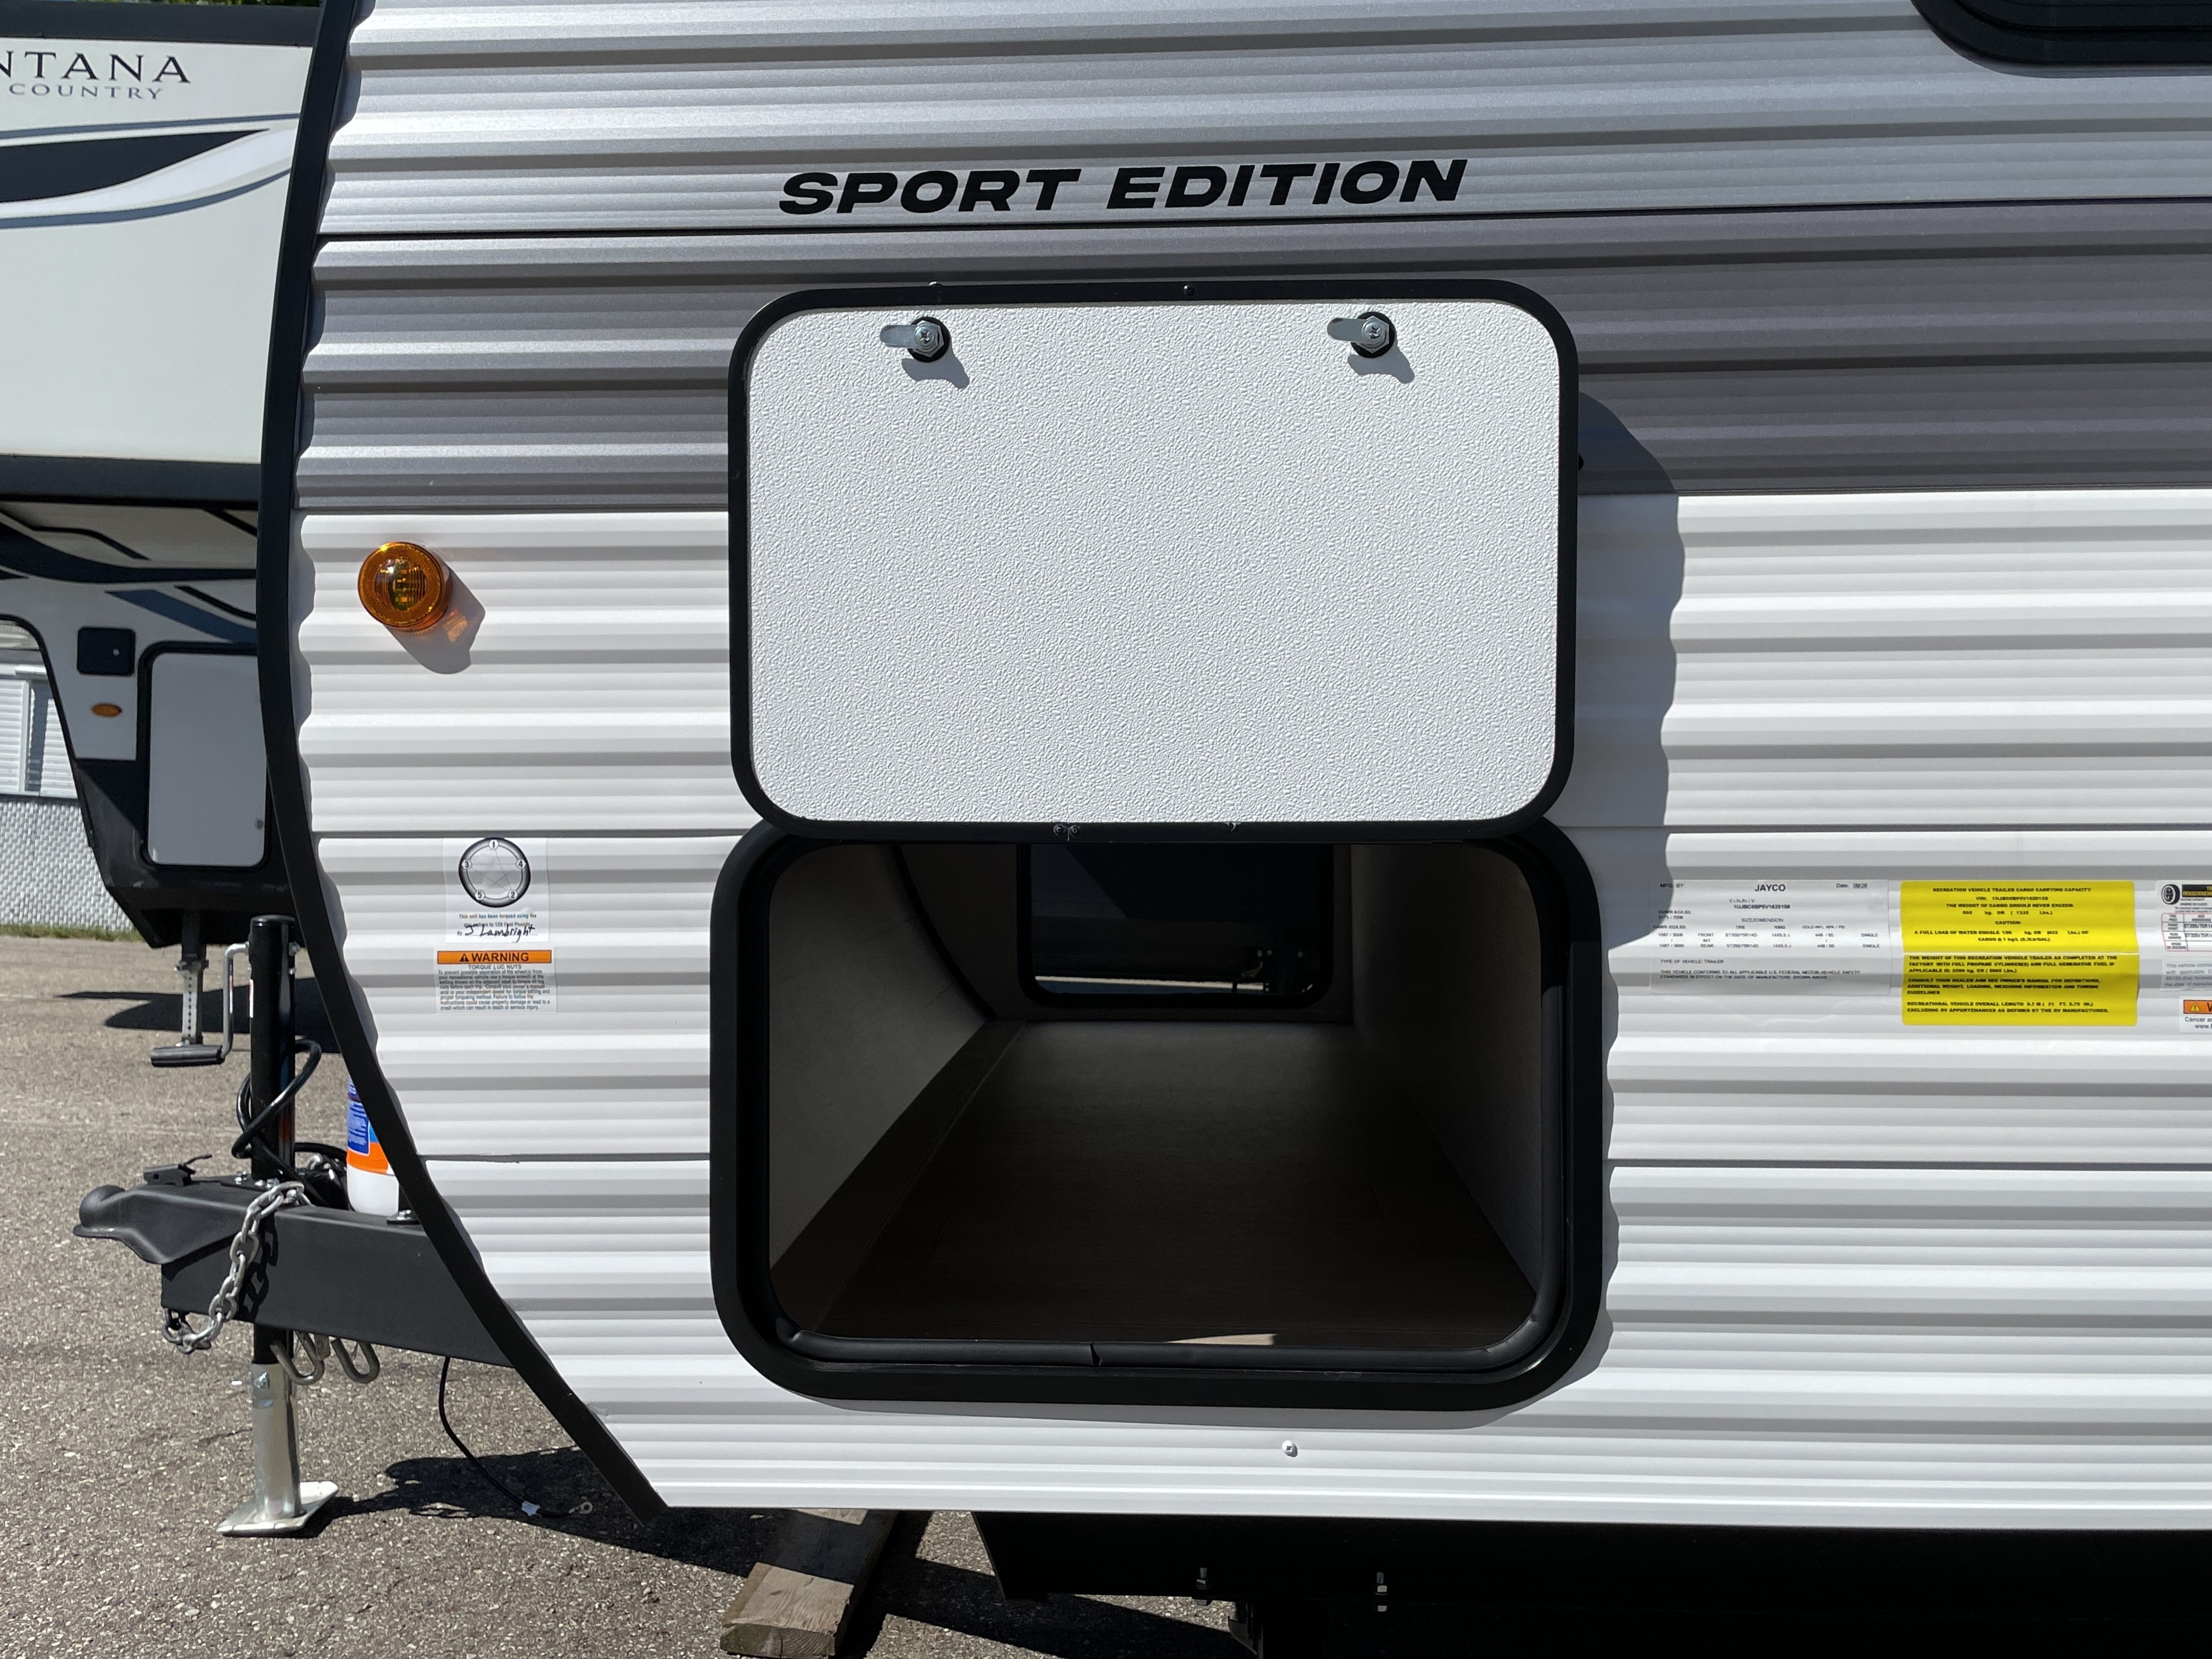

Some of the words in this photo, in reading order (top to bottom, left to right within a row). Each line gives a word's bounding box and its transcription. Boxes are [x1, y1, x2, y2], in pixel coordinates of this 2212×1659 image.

[9, 82, 162, 100] COUNTRY
[778, 168, 1082, 215] SPORT
[1106, 159, 1468, 209] EDITION
[1754, 884, 1786, 892] JAYCO
[471, 952, 529, 962] WARNING
